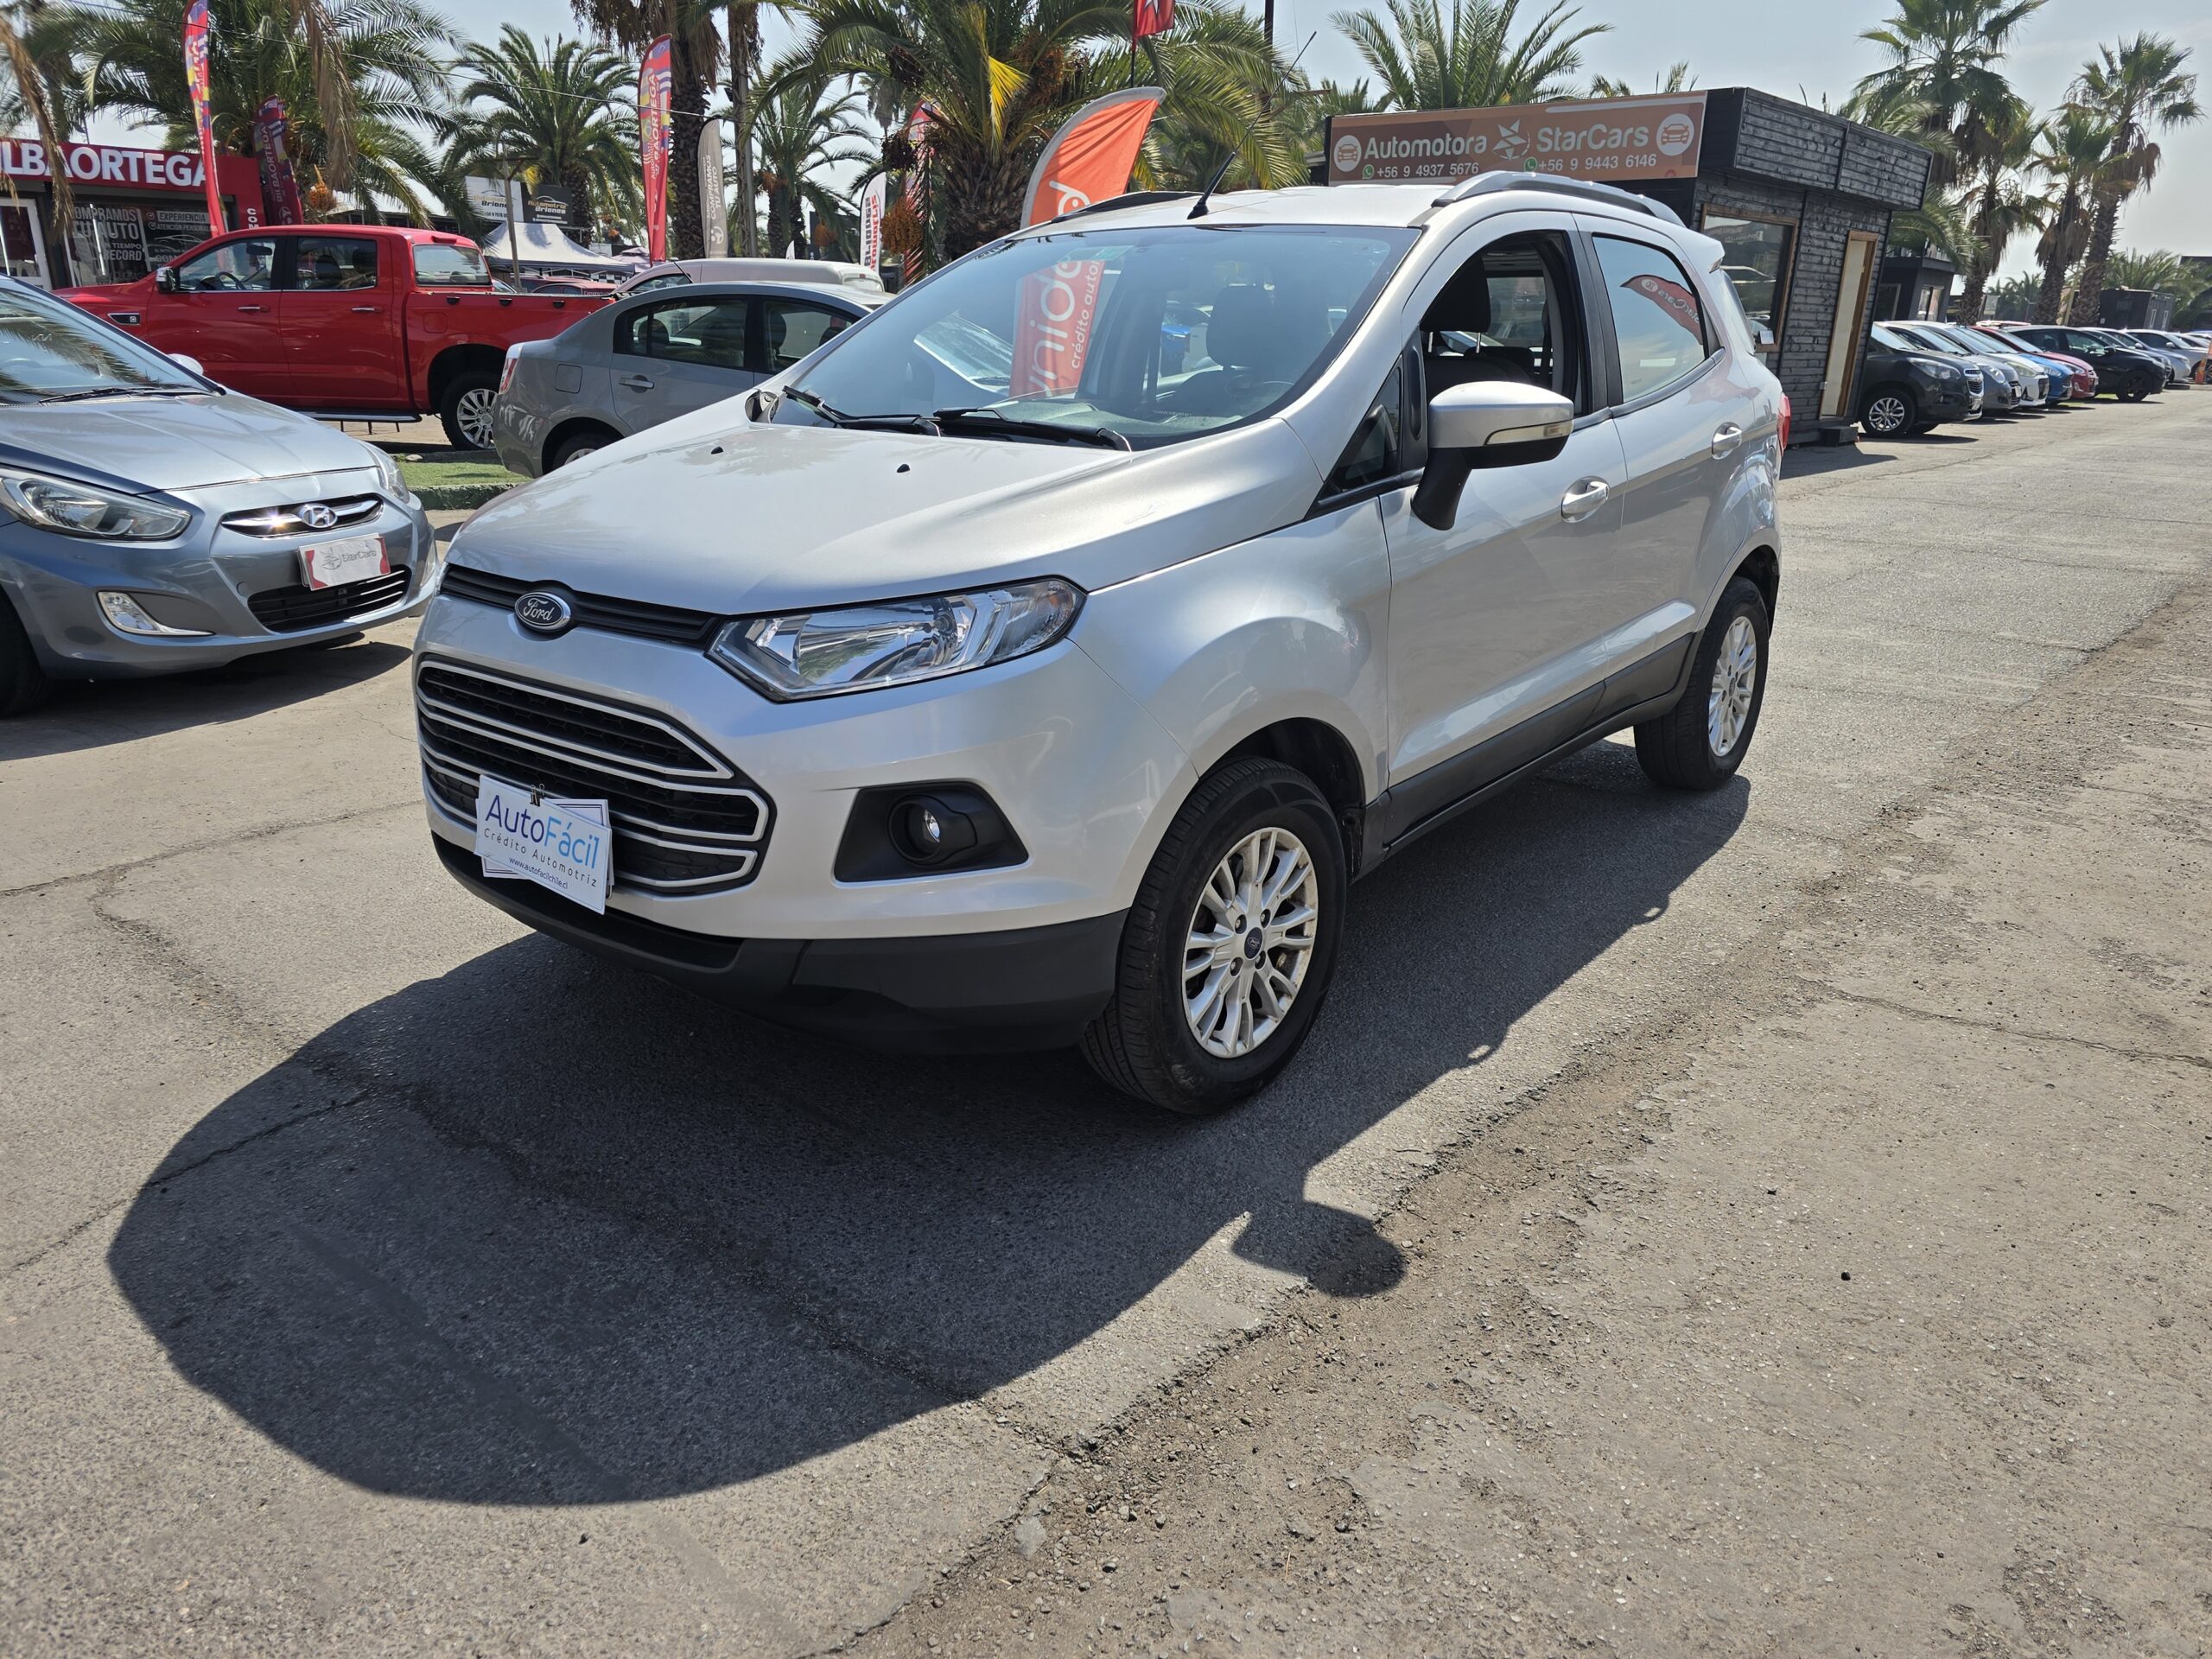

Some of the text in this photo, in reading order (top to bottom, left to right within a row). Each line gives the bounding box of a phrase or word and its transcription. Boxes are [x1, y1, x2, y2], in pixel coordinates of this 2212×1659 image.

[1363, 132, 1487, 160] Automotora
[1535, 124, 1649, 153] StarCars
[1376, 162, 1479, 178] +56 9 4937 5676
[1539, 154, 1657, 172] +56 9 9443 6146
[706, 155, 717, 220] COMPRAMOS
[73, 207, 137, 221] OMPRAMOS
[481, 200, 507, 208] Brion
[159, 213, 206, 222] EXPERIENCIA
[1071, 258, 1101, 369] crédito auto
[523, 597, 556, 621] Ford
[485, 794, 600, 869] AutoFácil
[484, 828, 598, 888] Crédito Automotriz
